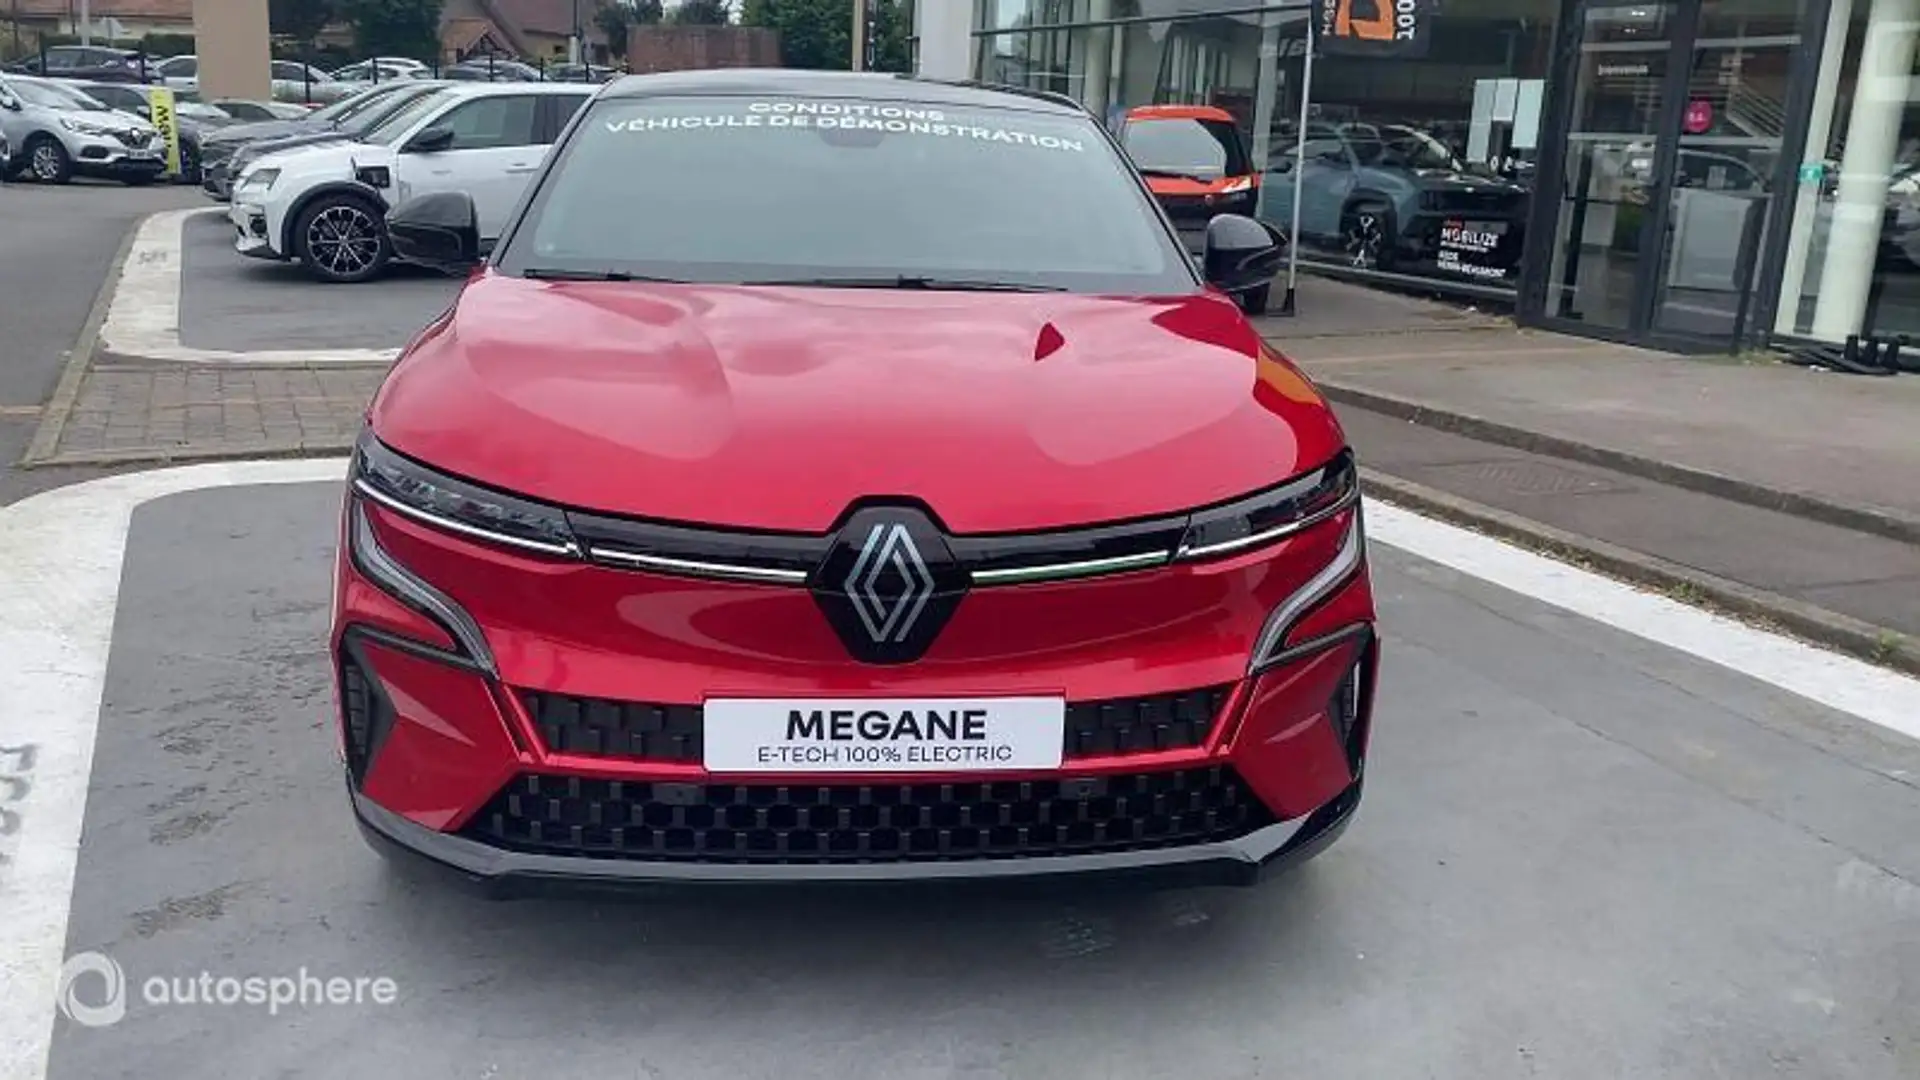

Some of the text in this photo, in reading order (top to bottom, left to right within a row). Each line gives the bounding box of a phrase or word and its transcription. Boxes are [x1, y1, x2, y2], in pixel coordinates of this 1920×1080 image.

[749, 102, 944, 122] CONDITIONS
[606, 115, 1084, 152] VÉHICULE DE DÉMONSTRATION
[786, 710, 987, 741] MEGANE
[757, 744, 1013, 763] E-TECH 100% ELECTRIC
